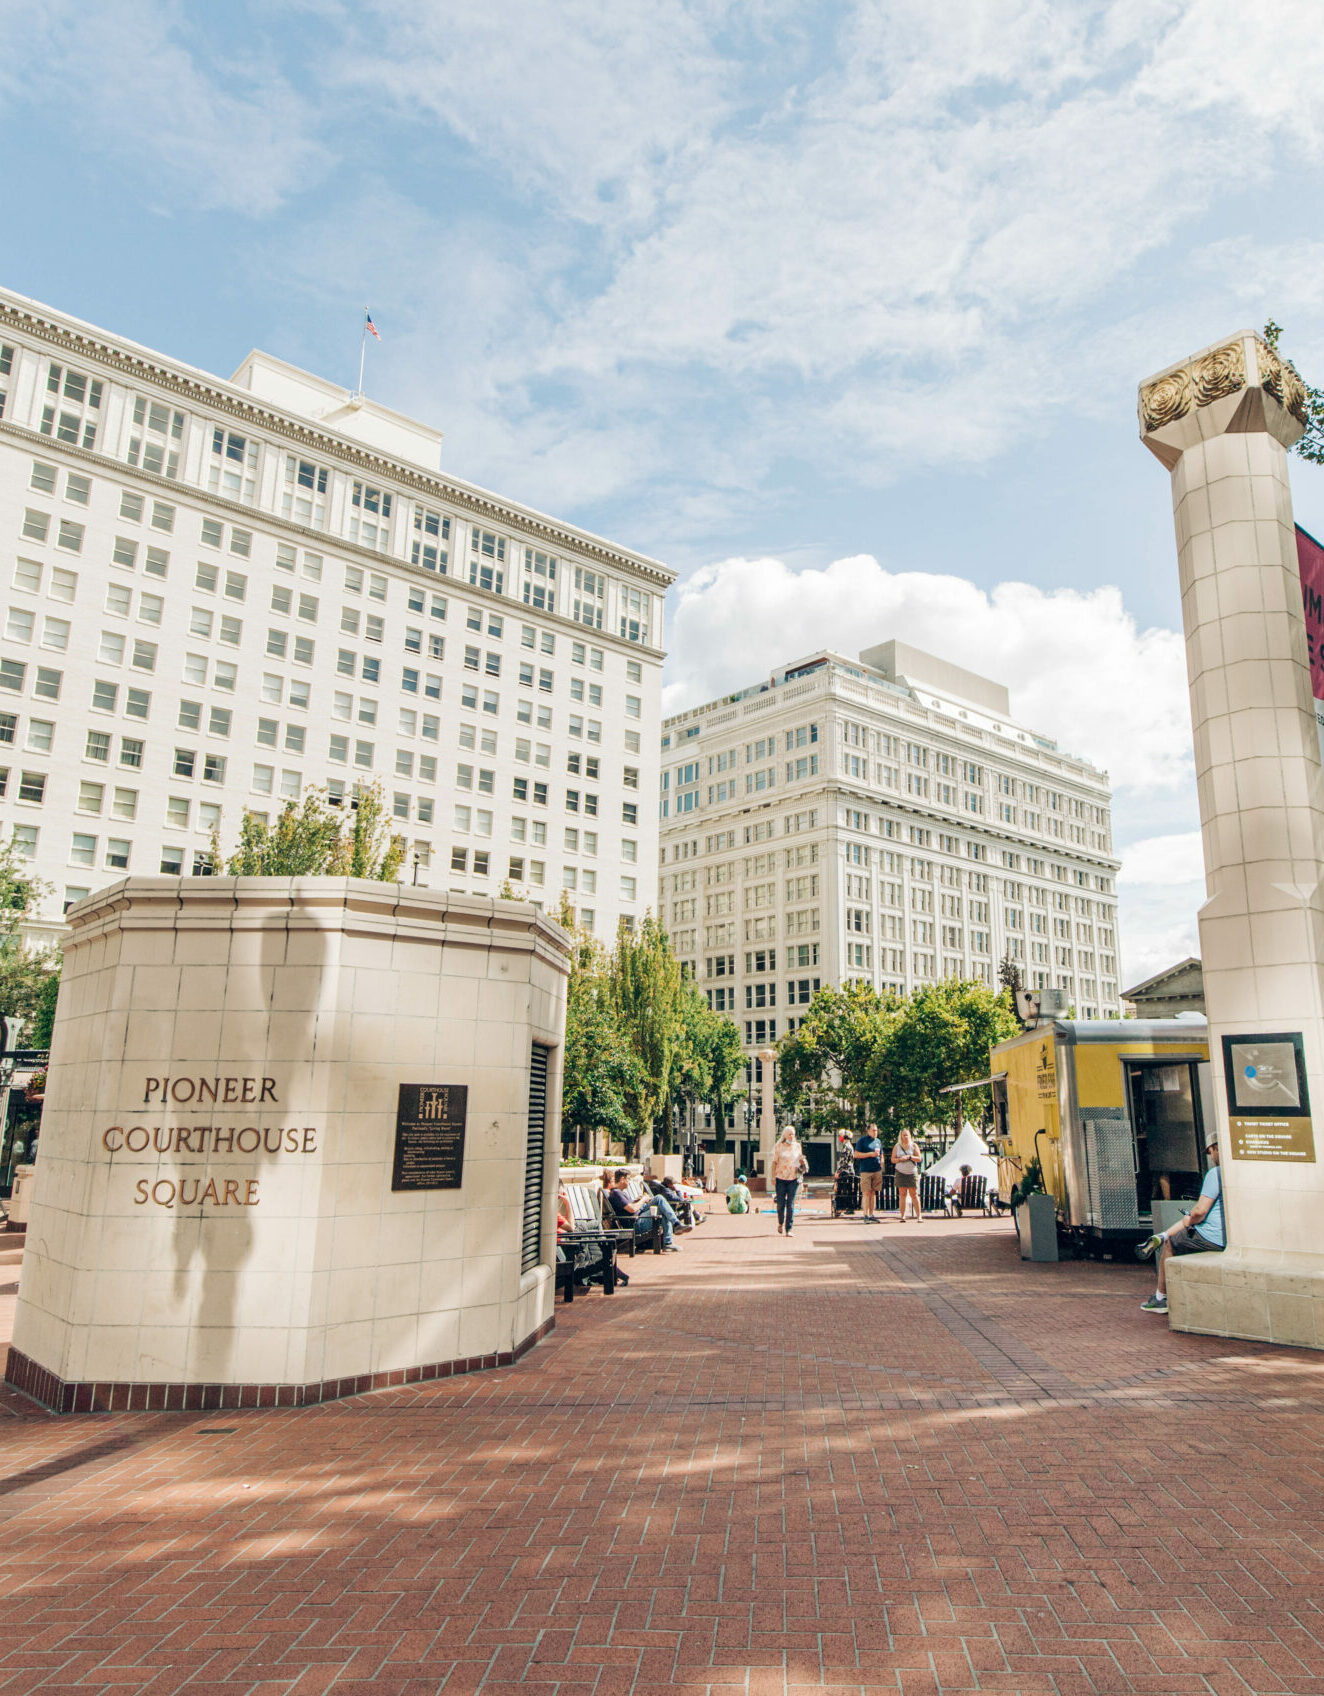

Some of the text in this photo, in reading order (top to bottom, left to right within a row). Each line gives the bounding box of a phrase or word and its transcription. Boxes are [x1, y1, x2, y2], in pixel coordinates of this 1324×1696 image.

[143, 1077, 278, 1103] PIONEER
[101, 1126, 317, 1153] COURTHOUSE
[133, 1178, 260, 1208] SQUARE
